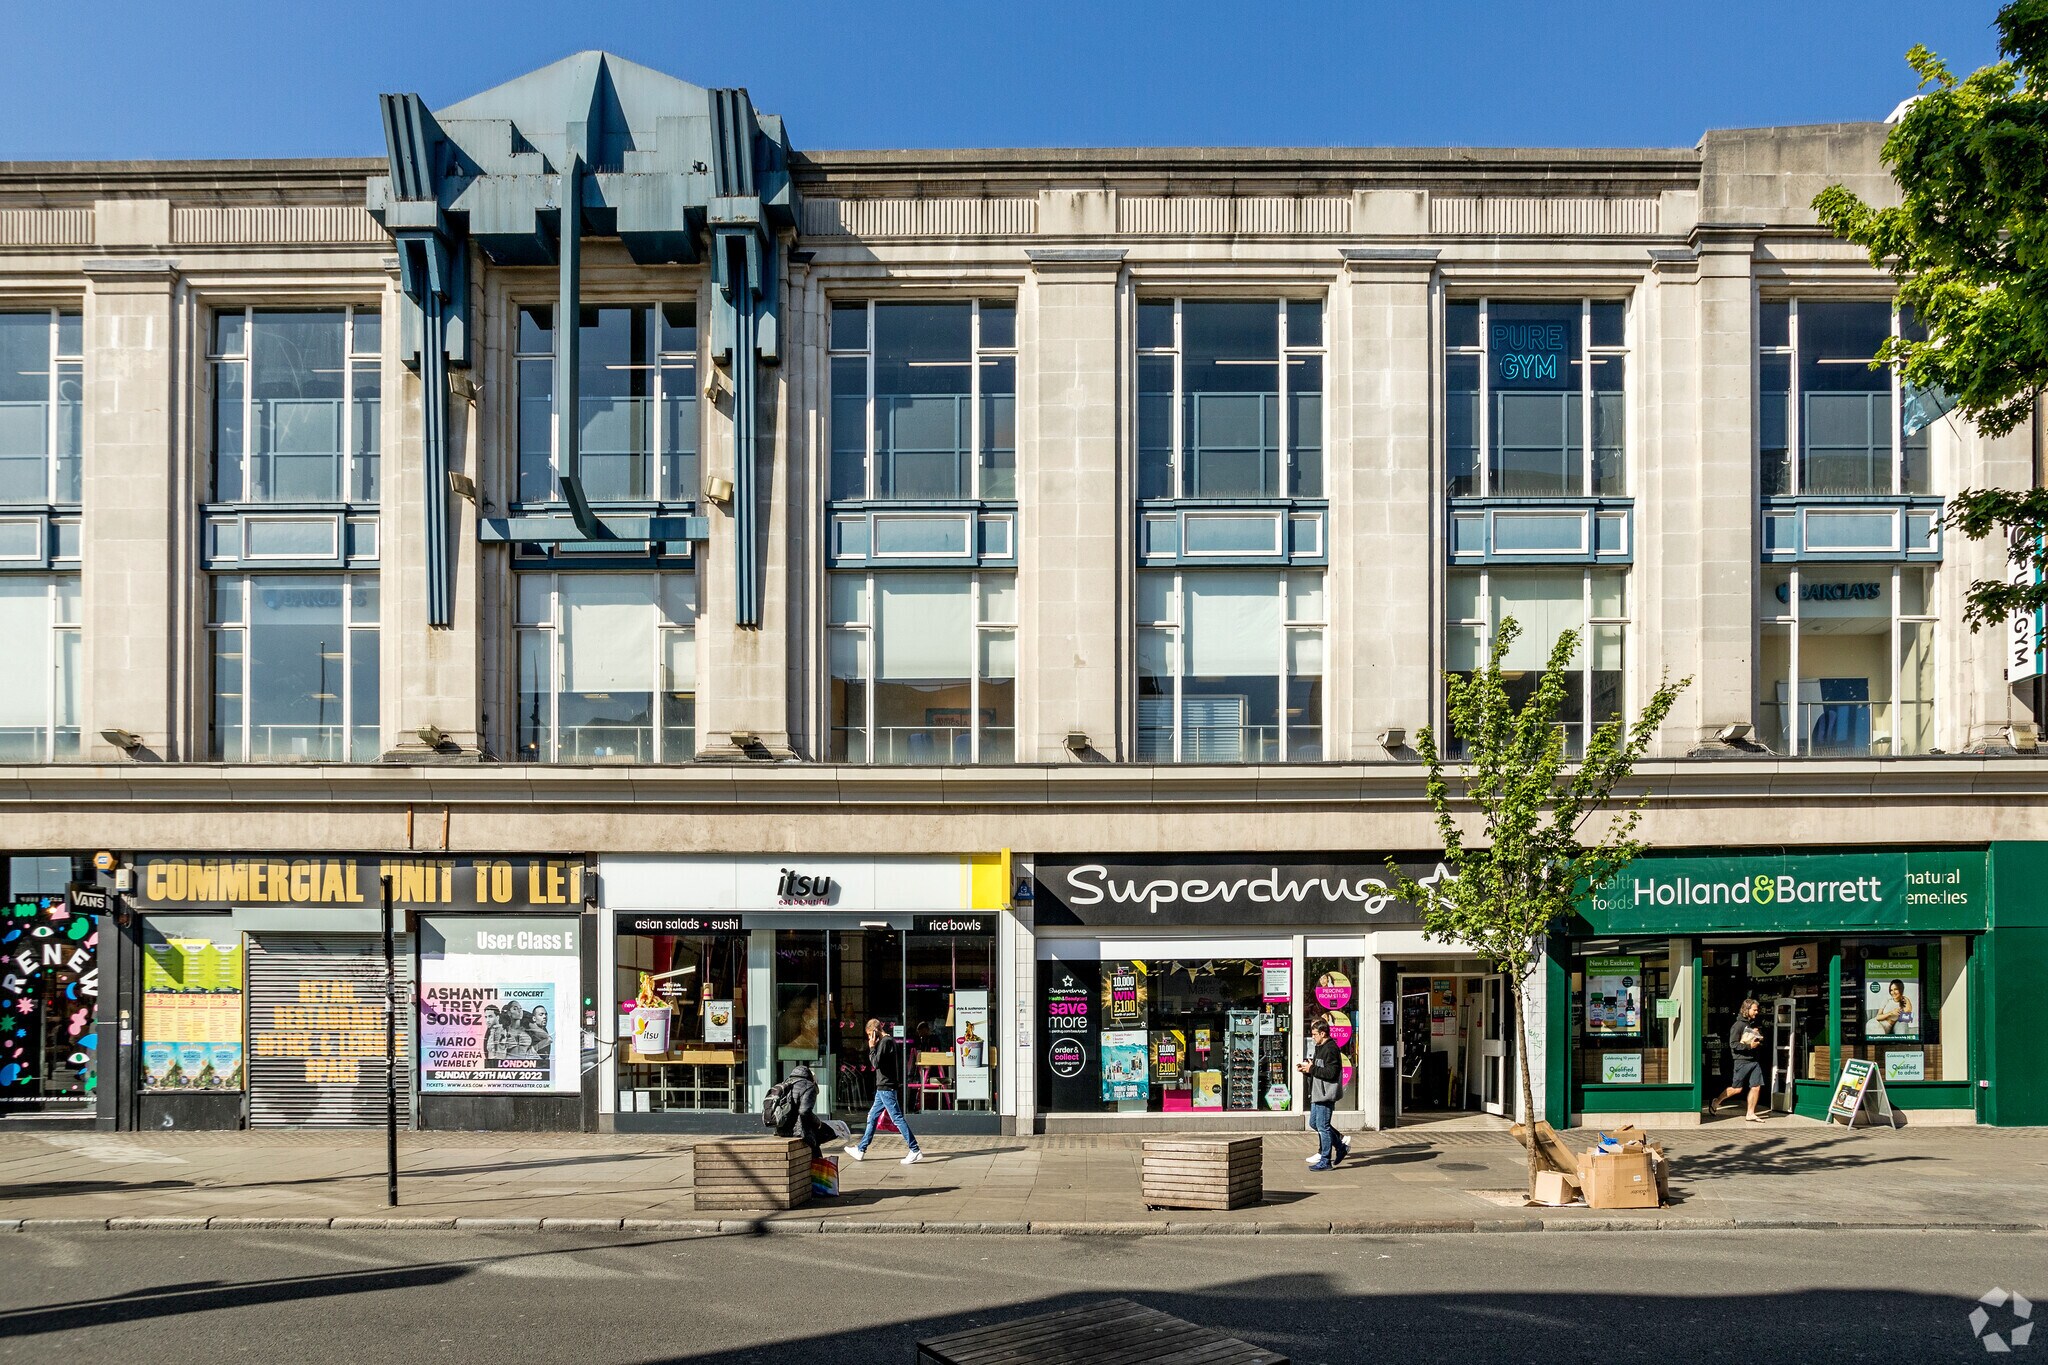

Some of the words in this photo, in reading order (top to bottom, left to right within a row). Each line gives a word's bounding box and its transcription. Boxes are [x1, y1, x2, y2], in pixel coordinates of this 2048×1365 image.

[1492, 325, 1563, 350] PURE
[1501, 354, 1556, 379] GYM
[1799, 583, 1880, 600] BARCLAYS
[2014, 618, 2028, 667] GYM
[147, 858, 364, 902] COMMERCIAL
[473, 861, 513, 903] TO
[528, 861, 584, 904] LET
[777, 868, 831, 896] itsu
[1905, 868, 1960, 885] natural
[1066, 865, 1396, 914] Superdrug
[72, 891, 105, 908] VANS
[1591, 894, 1634, 910] foods
[635, 919, 662, 929] asian
[665, 918, 699, 929] salads
[712, 918, 739, 929] sushi
[477, 932, 514, 949] User
[517, 932, 561, 949] Class
[565, 932, 573, 949] E
[2, 943, 98, 996] RENEW
[1113, 976, 1134, 988] 10,000
[427, 988, 498, 1000] ASHANTI
[1114, 991, 1135, 1000] WIN
[440, 1001, 483, 1012] TREY
[1049, 1002, 1087, 1015] save
[1114, 1000, 1135, 1012] £100
[274, 1006, 384, 1030] RESTAURANT
[426, 1013, 482, 1025] SONGZ
[1048, 1017, 1087, 1028] more
[257, 1032, 312, 1056] OFFICE
[339, 1033, 407, 1056] LEISUE
[436, 1037, 476, 1047] MARIO
[429, 1051, 448, 1059] OVO
[305, 1059, 360, 1083] SPACE
[498, 1060, 536, 1068] LONDON
[1159, 1063, 1175, 1072] £100
[1892, 1063, 1916, 1071] Qualified
[435, 1071, 470, 1080] SUNDAY
[473, 1071, 496, 1080] 29TH
[498, 1071, 518, 1080] MAY
[520, 1071, 542, 1080] 2022
